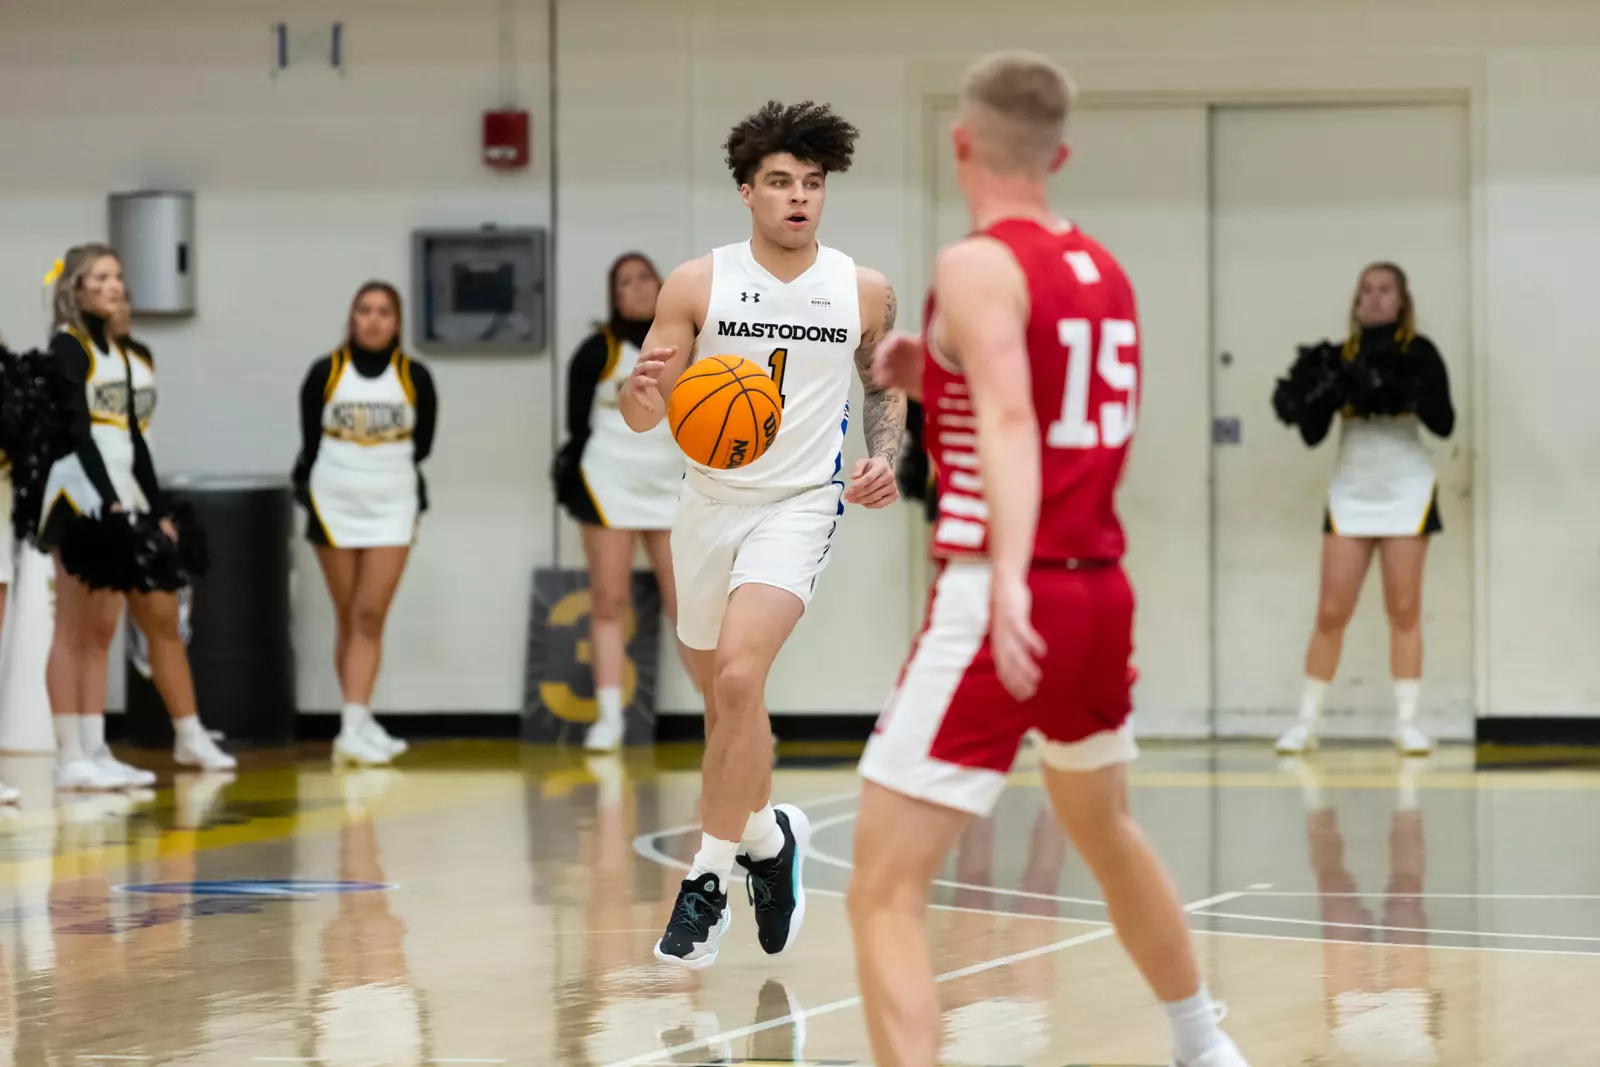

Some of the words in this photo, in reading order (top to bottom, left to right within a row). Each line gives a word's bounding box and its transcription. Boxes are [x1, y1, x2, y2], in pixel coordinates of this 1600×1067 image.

[718, 320, 848, 343] MASTODONS
[768, 347, 788, 409] 1
[1047, 317, 1136, 448] 15
[540, 588, 638, 724] 3
